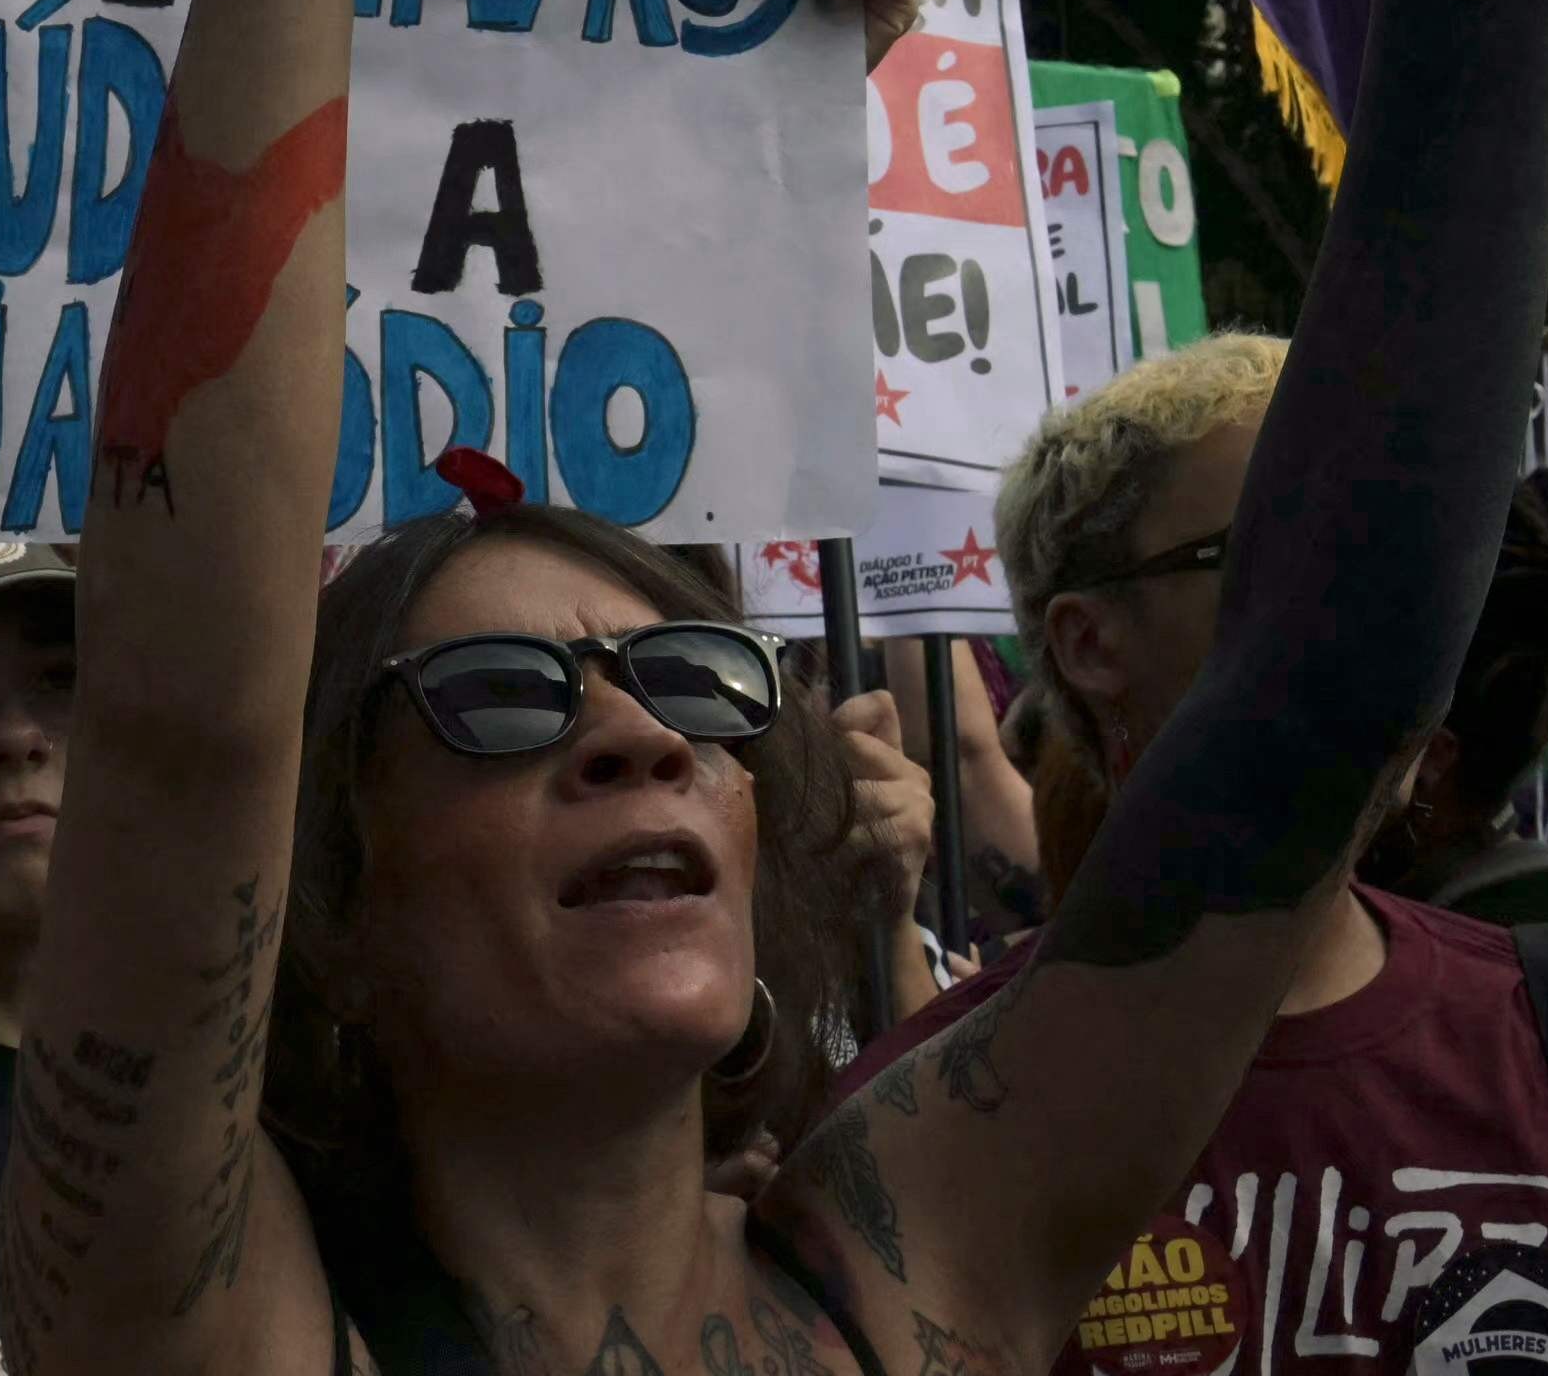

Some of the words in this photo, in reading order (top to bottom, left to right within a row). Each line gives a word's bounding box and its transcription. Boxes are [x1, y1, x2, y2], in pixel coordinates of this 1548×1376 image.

[409, 121, 544, 295] A
[860, 553, 912, 573] DIÁLOGO
[916, 552, 924, 566] E
[863, 566, 898, 589] AÇÃO
[901, 563, 954, 584] PETISTA
[874, 579, 952, 600] ASSOCIAÇÃO
[1081, 1283, 1231, 1319] NGOLIMOS
[1079, 1307, 1236, 1351] REDPILL
[1442, 1335, 1547, 1363] MULHERES
